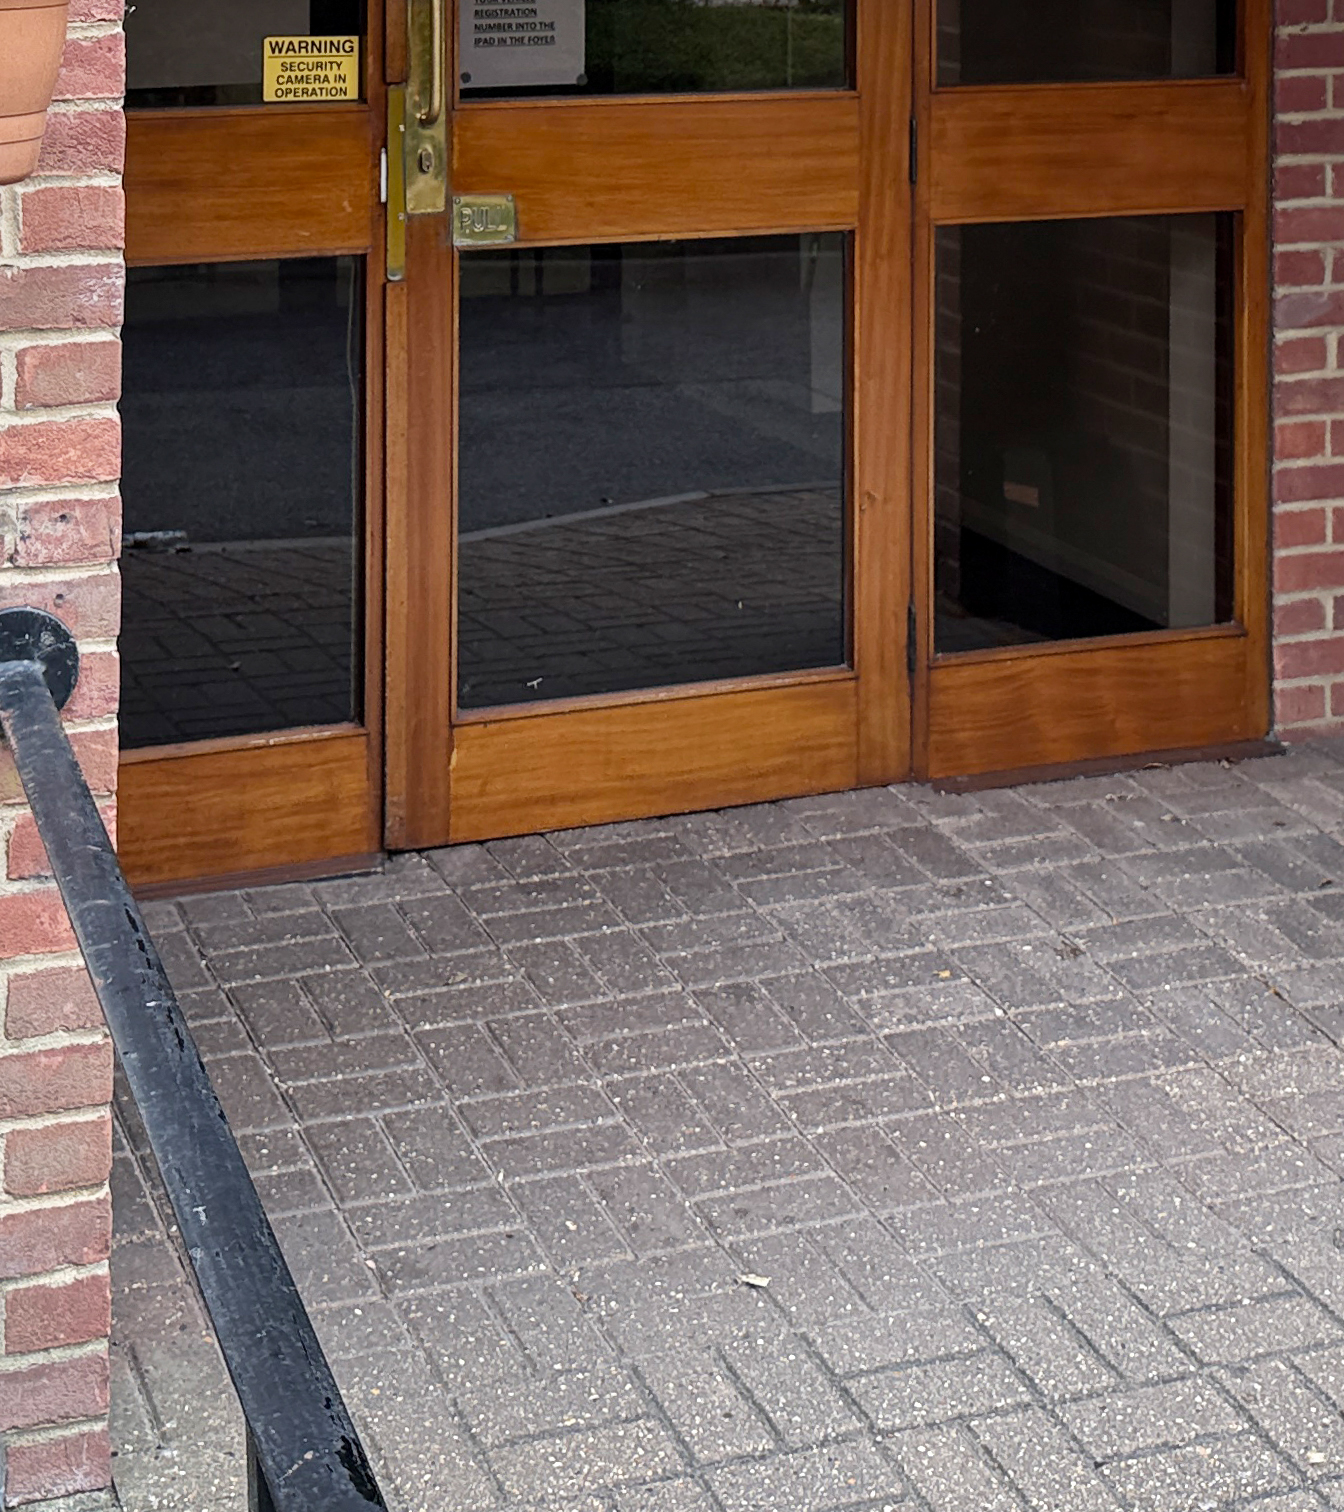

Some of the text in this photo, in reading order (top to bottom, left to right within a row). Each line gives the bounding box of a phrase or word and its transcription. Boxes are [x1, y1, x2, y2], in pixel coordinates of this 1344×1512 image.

[474, 8, 538, 18] REGISTRATION
[474, 21, 555, 32] NUMBER INTO THE
[497, 37, 507, 45] IN
[508, 36, 525, 45] THE
[528, 35, 555, 44] FOYER
[269, 39, 355, 55] WARNING
[280, 60, 344, 73] SECURITY
[276, 73, 347, 86] CAMERA IN
[274, 85, 348, 99] OPERATION
[460, 206, 508, 233] PULL
